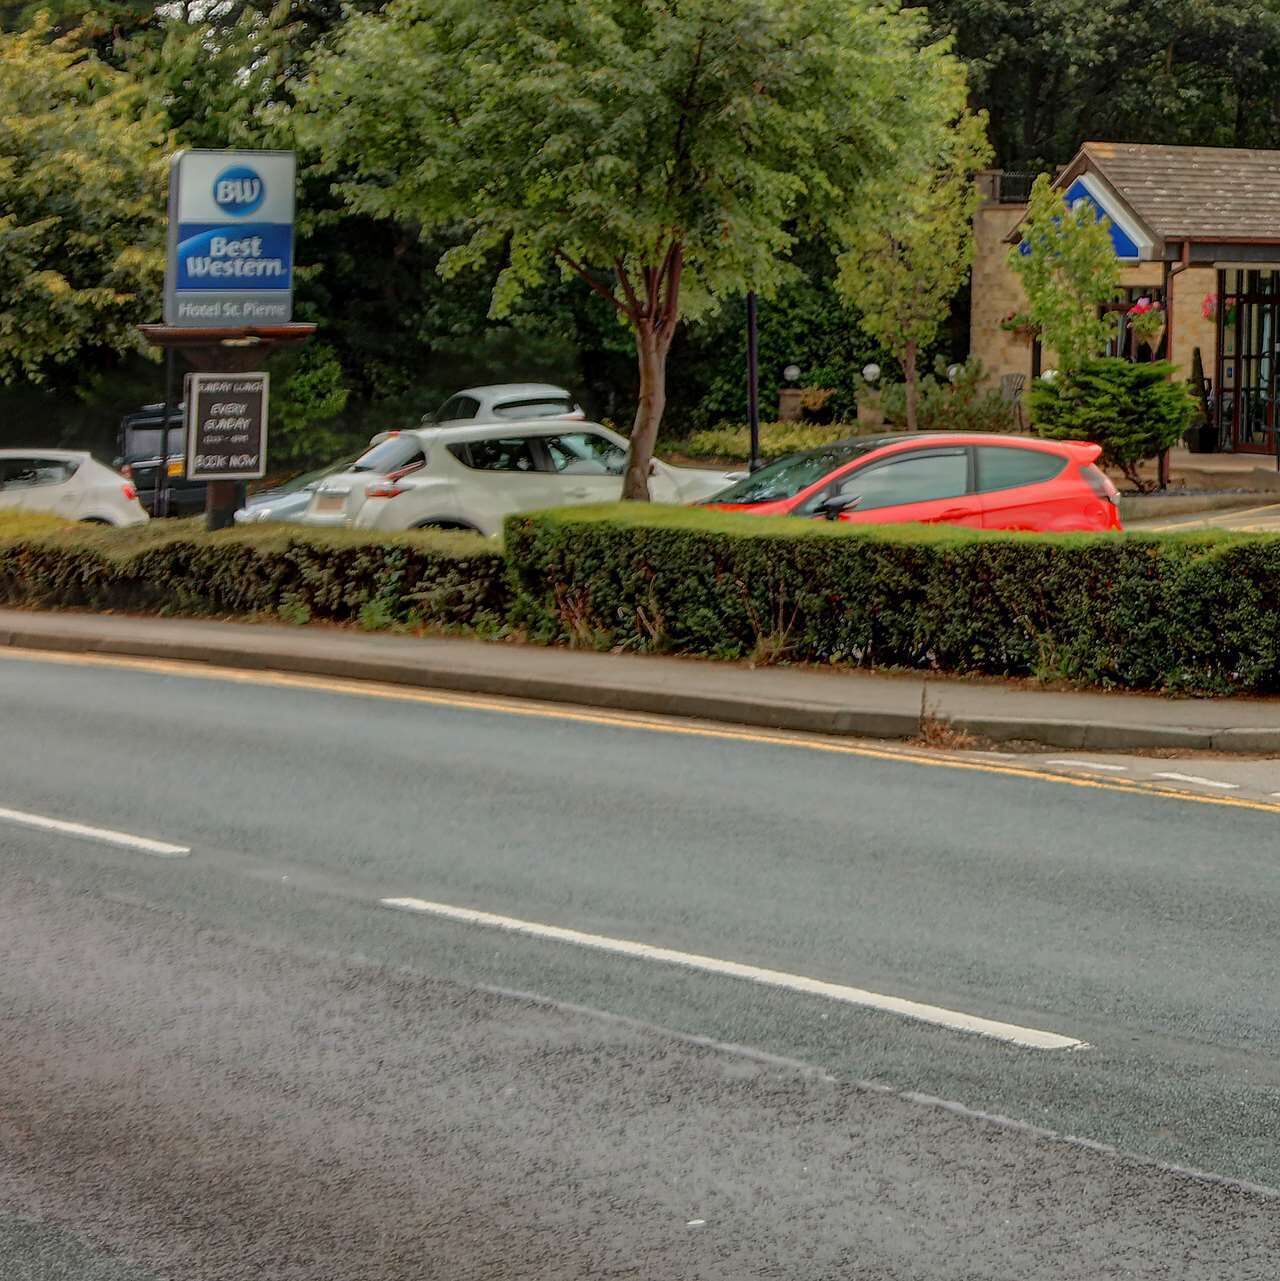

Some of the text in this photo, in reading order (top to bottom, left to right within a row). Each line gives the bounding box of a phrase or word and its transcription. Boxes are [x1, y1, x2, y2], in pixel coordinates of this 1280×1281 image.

[216, 177, 261, 204] BW
[210, 236, 263, 257] Best
[186, 257, 282, 278] Western
[178, 302, 222, 317] Hotel
[243, 303, 286, 317] Pierre
[210, 402, 248, 417] EVERY
[203, 418, 252, 433] SUNDAY
[194, 454, 259, 469] BOOK NOW
